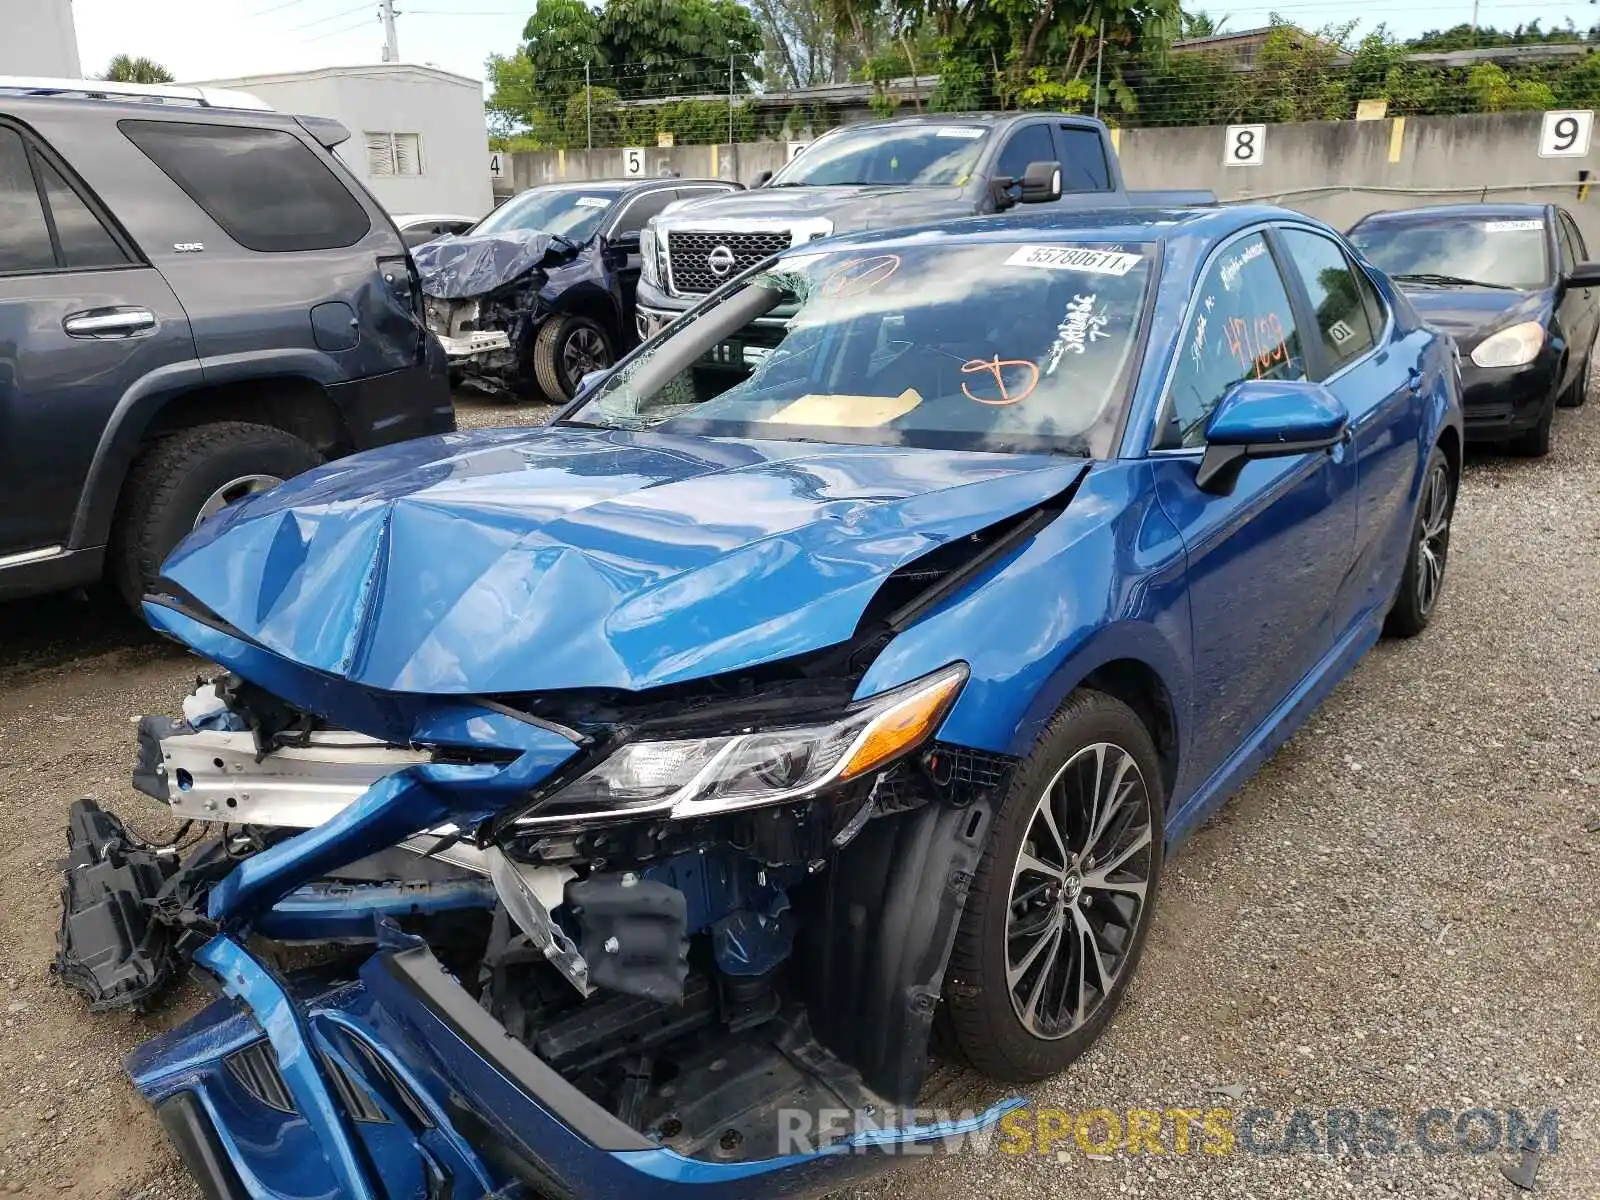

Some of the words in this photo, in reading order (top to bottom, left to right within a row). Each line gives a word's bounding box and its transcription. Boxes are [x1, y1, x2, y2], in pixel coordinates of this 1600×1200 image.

[1235, 130, 1255, 160] 8
[1553, 117, 1579, 151] 9
[490, 155, 500, 175] 4
[629, 151, 640, 173] 5
